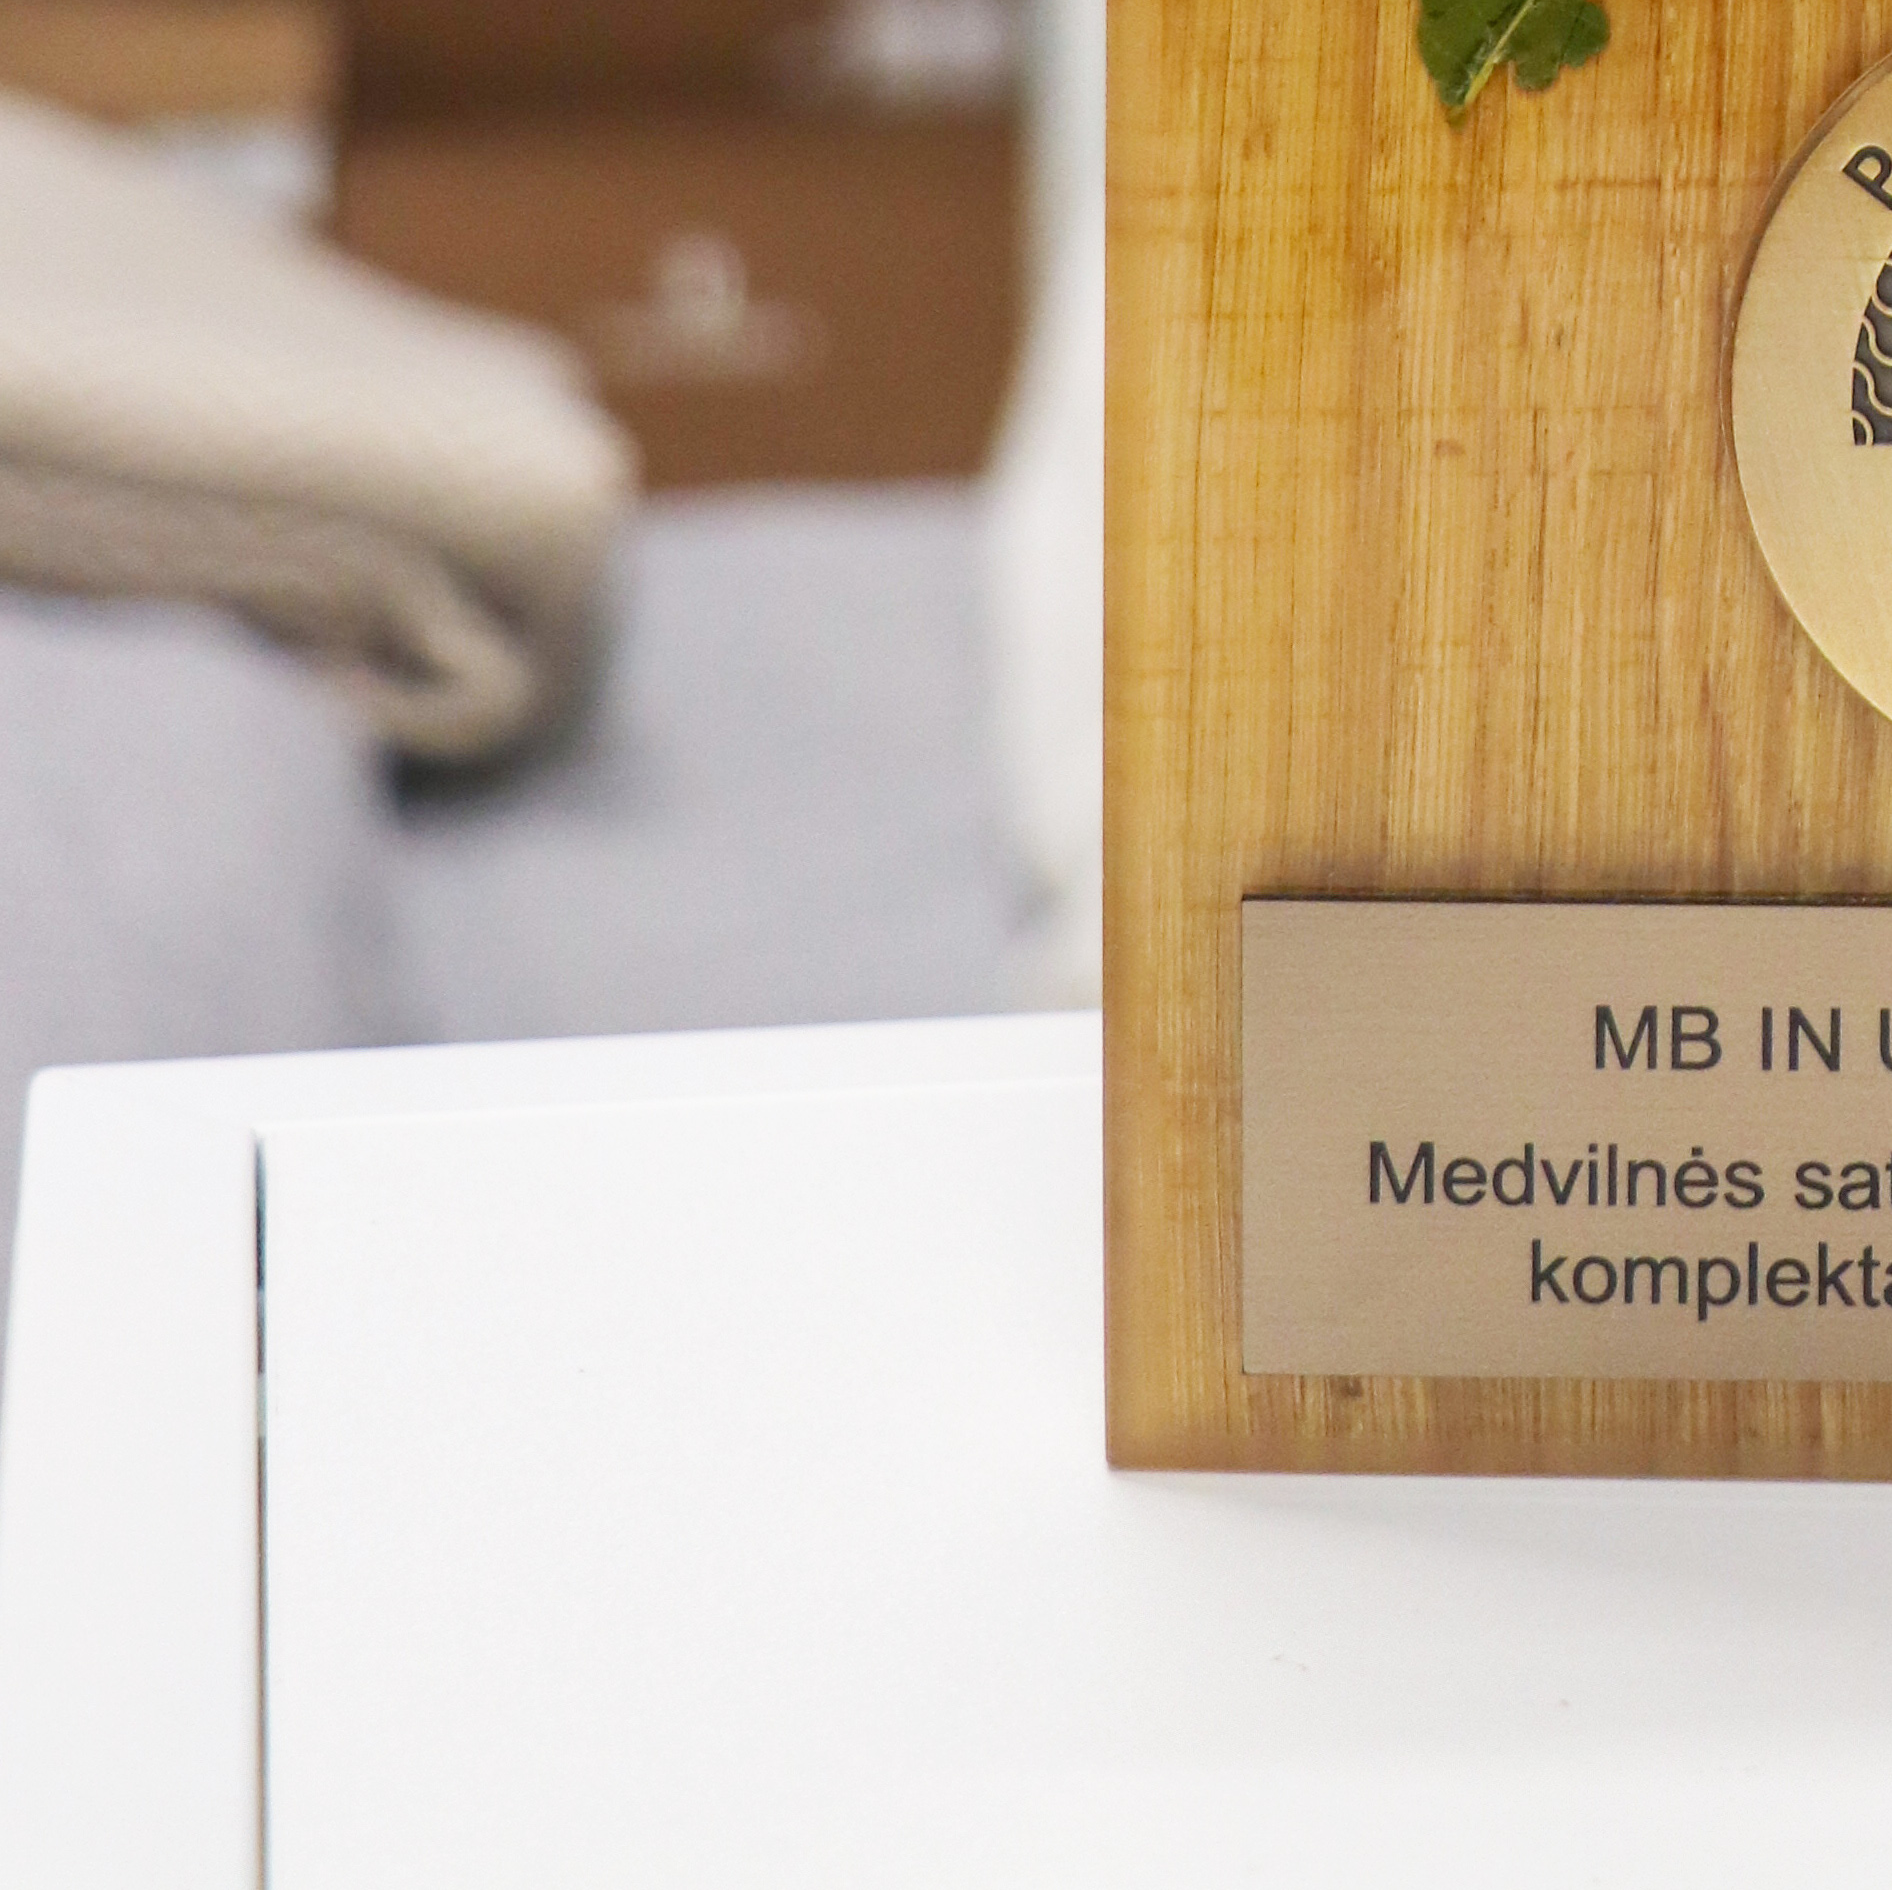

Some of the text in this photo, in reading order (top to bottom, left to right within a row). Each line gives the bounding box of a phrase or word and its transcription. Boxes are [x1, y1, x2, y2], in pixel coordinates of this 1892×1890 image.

[1594, 1004, 1722, 1071] MB
[1761, 1006, 1841, 1073] IN
[1369, 1140, 1765, 1210] Medvilnės
